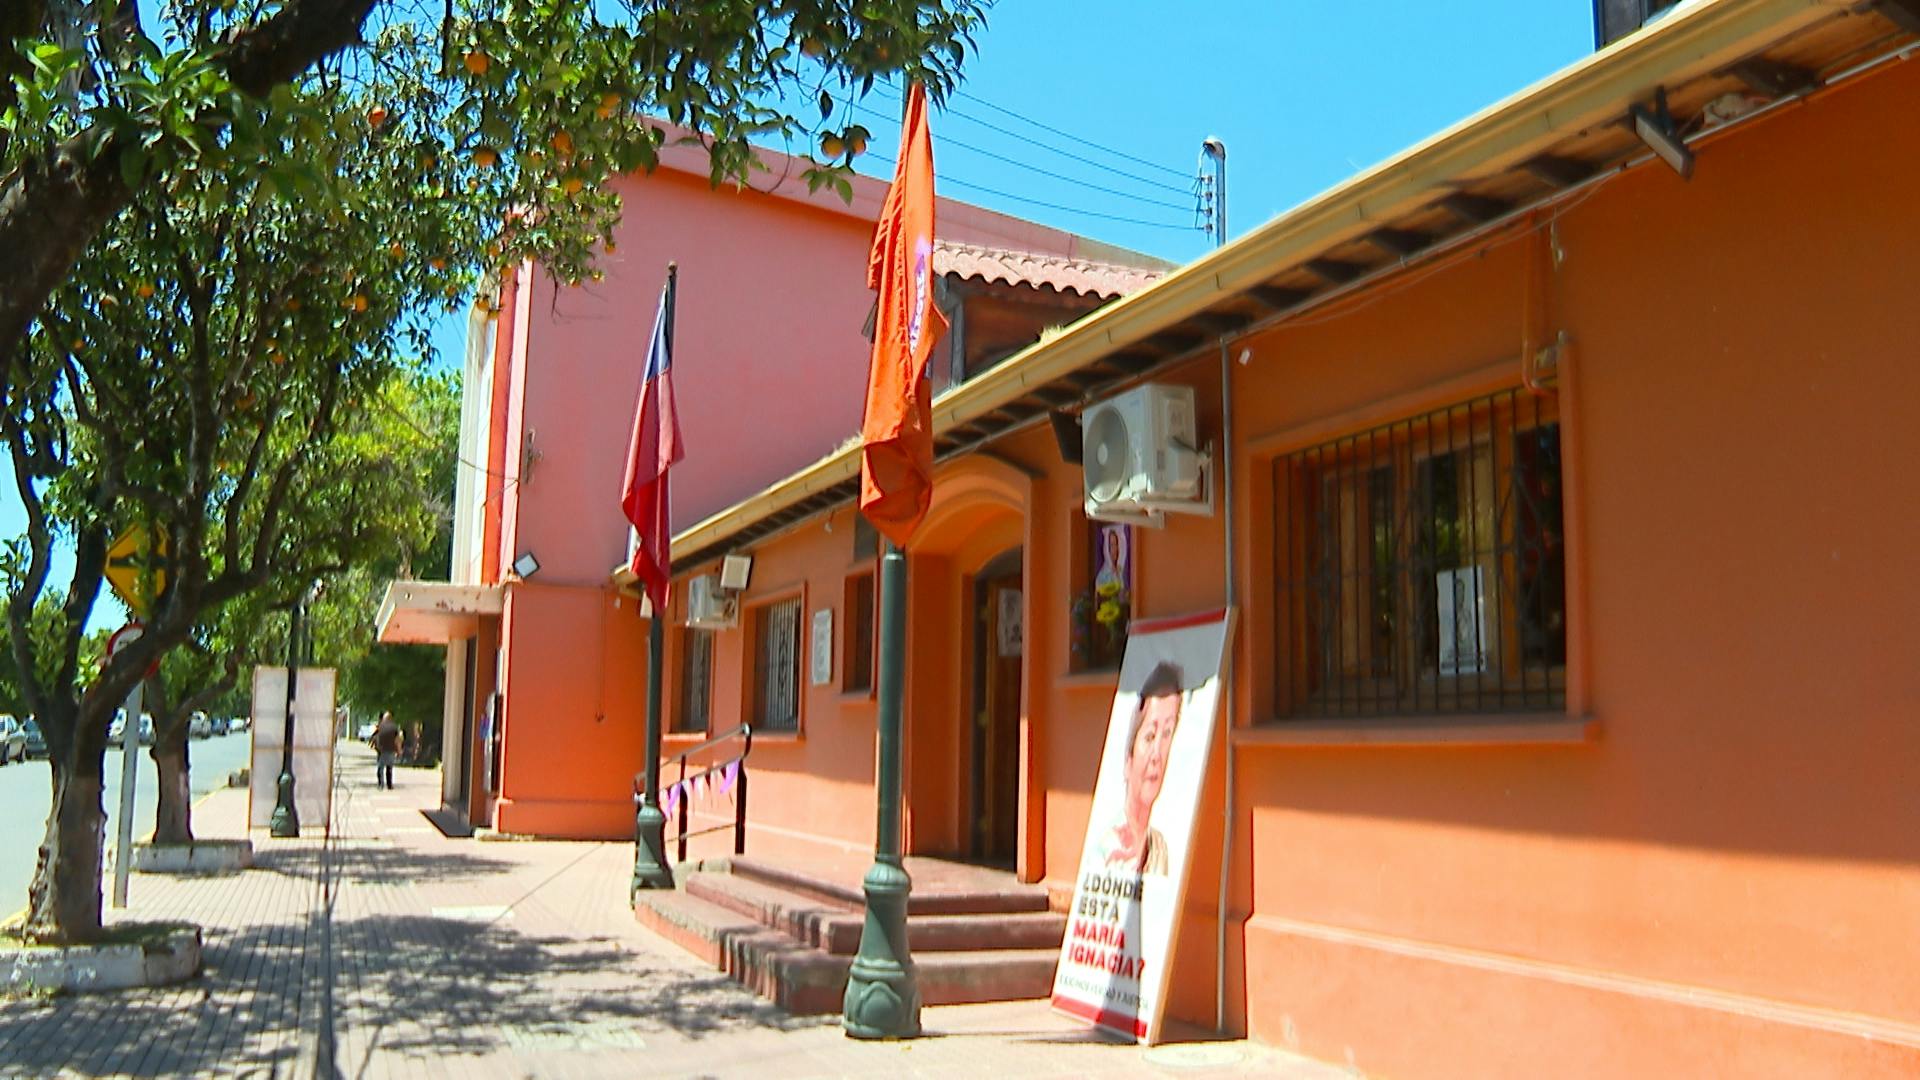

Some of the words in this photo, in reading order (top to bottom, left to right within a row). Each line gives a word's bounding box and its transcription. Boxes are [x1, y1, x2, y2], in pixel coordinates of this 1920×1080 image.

[1082, 870, 1143, 902] ¿DÓNDE
[1078, 895, 1119, 922] ESTÁ
[1073, 918, 1126, 950] MARÍA
[1068, 942, 1145, 981] IGNACIA?
